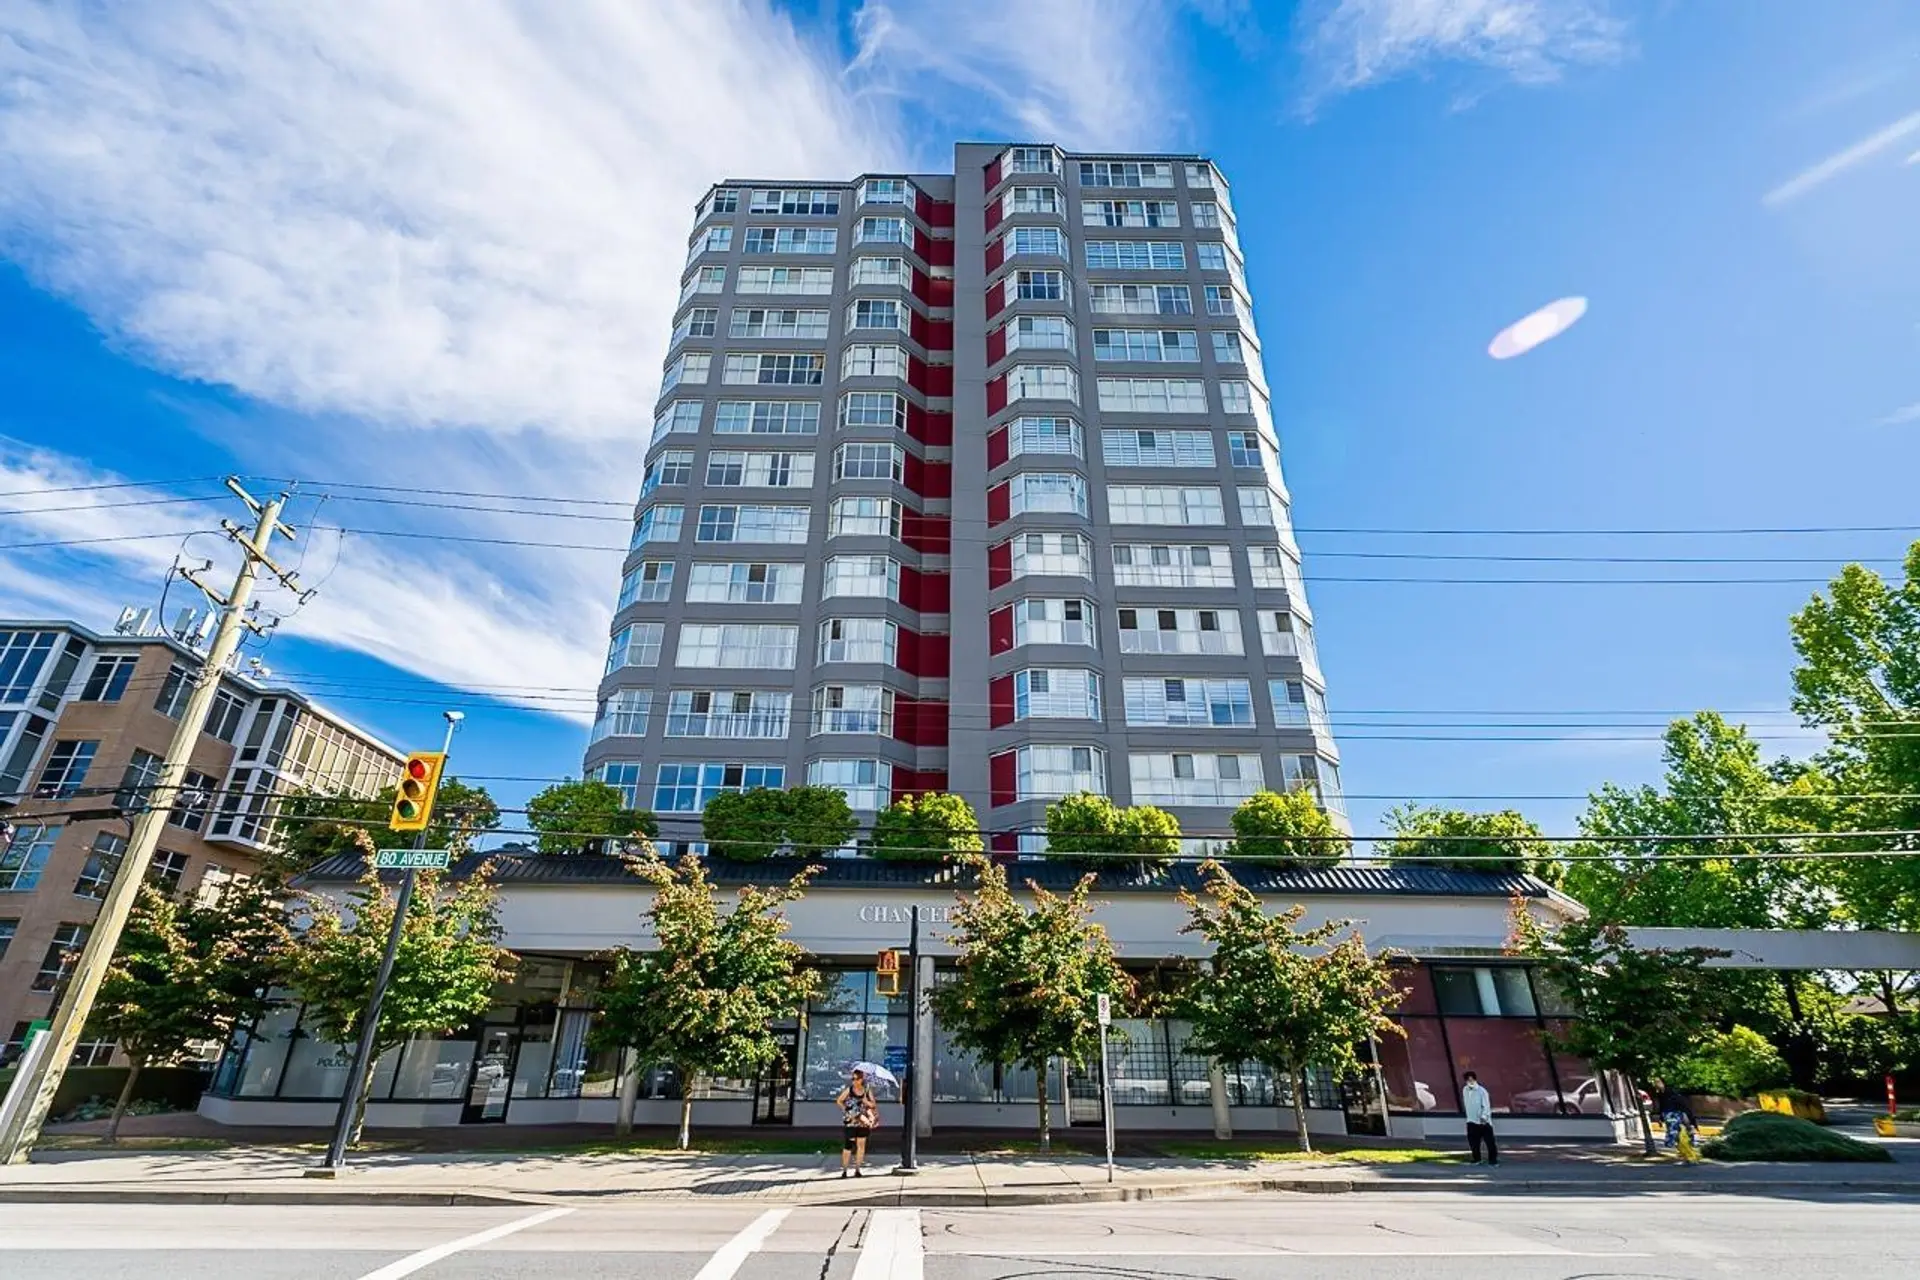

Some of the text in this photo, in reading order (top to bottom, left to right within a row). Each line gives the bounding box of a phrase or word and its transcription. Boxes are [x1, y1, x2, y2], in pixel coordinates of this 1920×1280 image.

[380, 852, 445, 866] 80 AVENUE
[860, 905, 961, 922] CHANCEL
